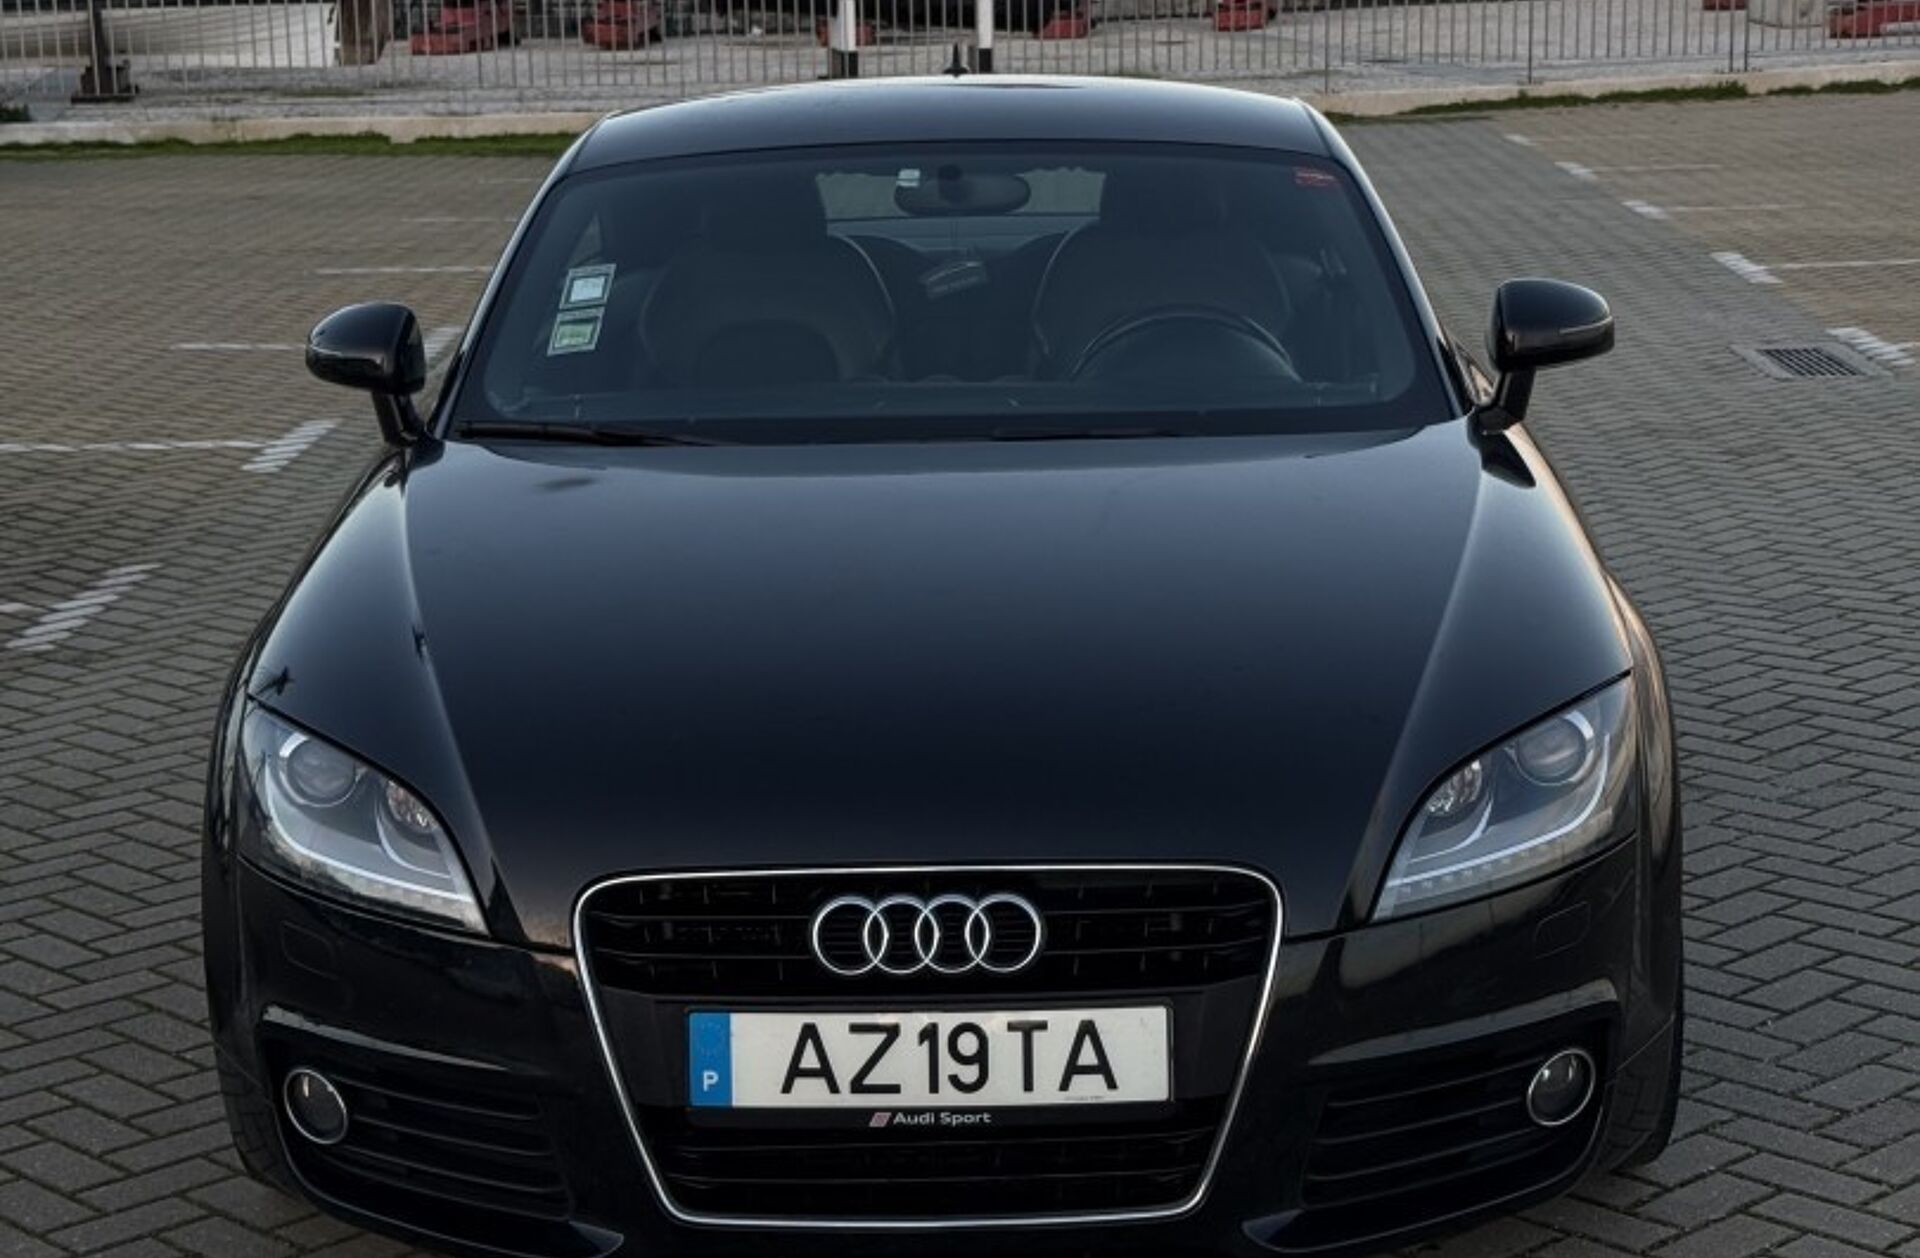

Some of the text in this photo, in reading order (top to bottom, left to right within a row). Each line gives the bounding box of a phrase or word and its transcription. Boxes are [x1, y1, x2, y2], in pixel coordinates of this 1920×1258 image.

[703, 1070, 719, 1091] P
[893, 1111, 991, 1127] Audi Sport
